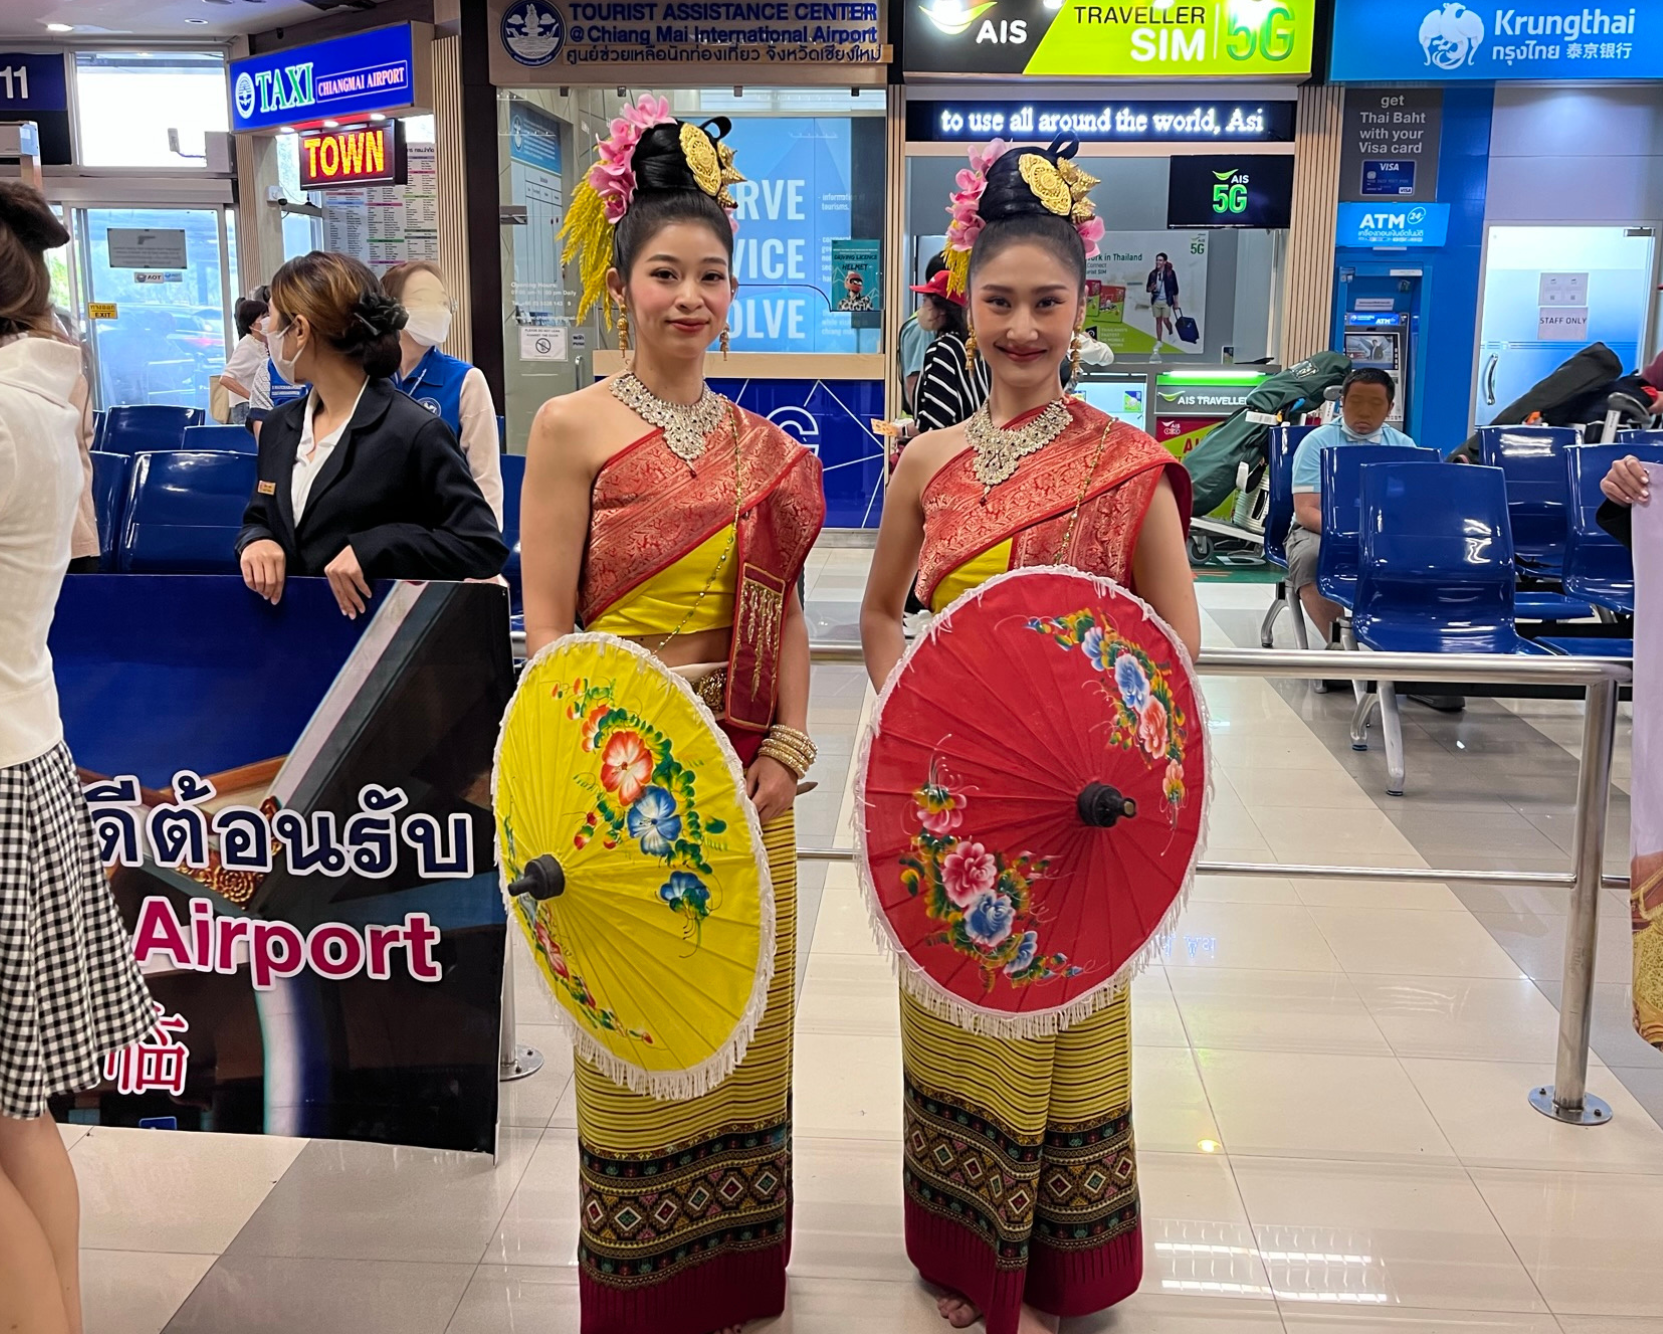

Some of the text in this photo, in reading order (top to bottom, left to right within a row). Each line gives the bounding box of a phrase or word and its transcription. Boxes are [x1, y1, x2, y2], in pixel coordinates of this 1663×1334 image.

[569, 3, 877, 21] TOURIST ASSISTANCE CENTER
[1074, 7, 1205, 24] TRAVELLER
[570, 26, 877, 45] @ Chiang Mai International Airport
[976, 20, 1028, 44] AIS
[1226, 8, 1296, 61] 5G
[1494, 8, 1636, 42] Krungthai
[1130, 28, 1206, 62] SIM
[1492, 40, 1560, 66] กรุงไทย
[1566, 42, 1632, 60] 泰京银行
[0, 66, 29, 99] 11
[255, 62, 315, 113] TAXI
[318, 67, 405, 97] CHIANGMAI AIRPORT
[1380, 95, 1405, 109] get
[941, 106, 1264, 135] to use all around the world, Asi
[1360, 112, 1426, 124] Thai Baht
[1359, 128, 1424, 142] with your
[304, 130, 385, 178] TOWN
[1359, 142, 1423, 153] Visa card
[1379, 162, 1400, 171] VISA
[1230, 174, 1250, 184] AIS
[736, 179, 806, 220] RVE
[1212, 183, 1248, 214] 5G
[1359, 213, 1406, 229] ATM
[733, 238, 806, 279] VICE
[1104, 253, 1111, 261] in
[1112, 253, 1143, 261] Thailand
[1190, 243, 1205, 255] 5G
[730, 299, 806, 339] OLVE
[1539, 317, 1587, 325] STAFF ONLY
[1177, 396, 1247, 405] AIS TRAVELLE
[84, 770, 474, 878] ดีต้อนรับ
[133, 896, 443, 990] Airport
